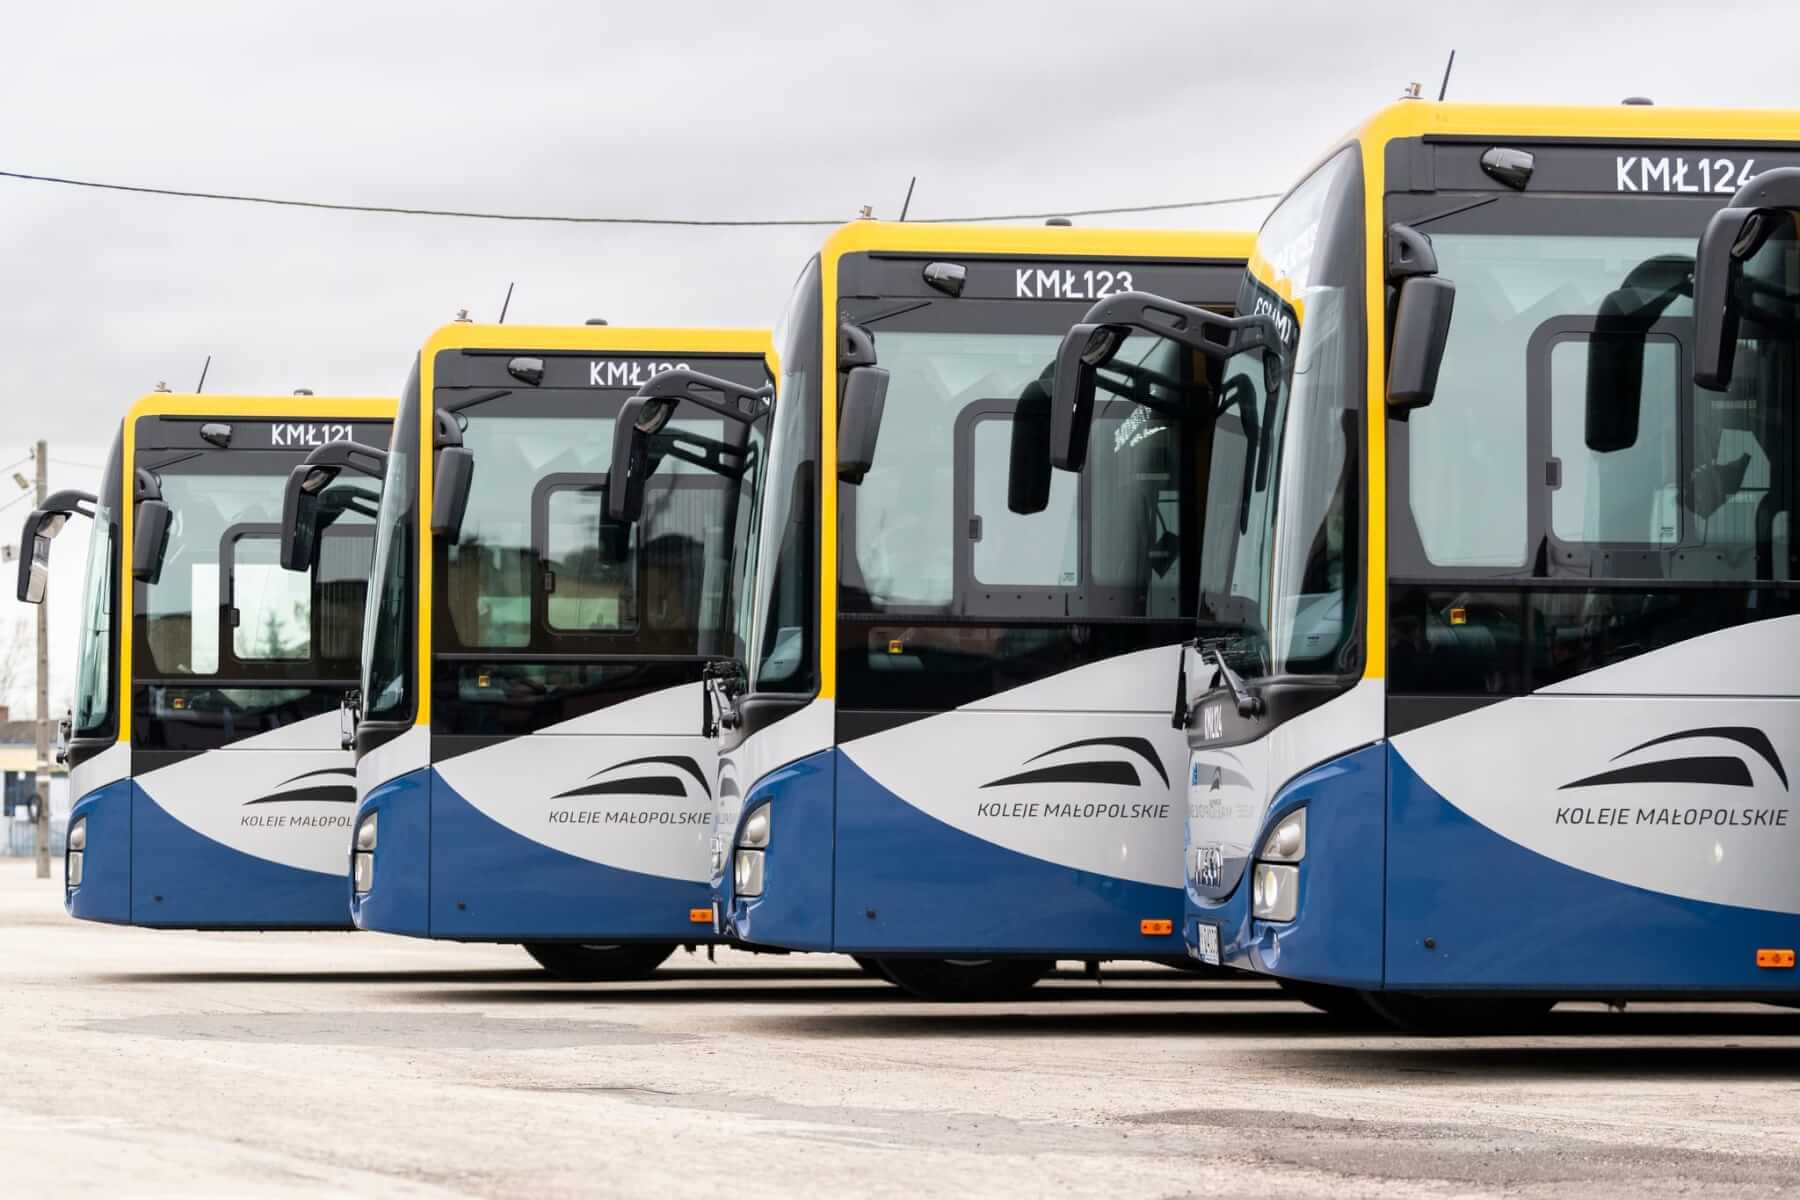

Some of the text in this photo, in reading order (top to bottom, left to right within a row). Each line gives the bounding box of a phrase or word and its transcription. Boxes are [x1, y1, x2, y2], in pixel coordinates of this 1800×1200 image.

[1016, 268, 1133, 299] KMŁ123
[590, 361, 690, 386] KMŁ1
[271, 423, 353, 446] KMŁ121
[549, 810, 712, 825] KOLEJE MAŁOPOLSKIE
[977, 802, 1170, 819] KOLEJE MAŁOPOLSKIE
[1555, 807, 1790, 826] KOLEJE MAŁOPOLSKIE
[240, 815, 353, 828] KOLEJE MAŁOPOL
